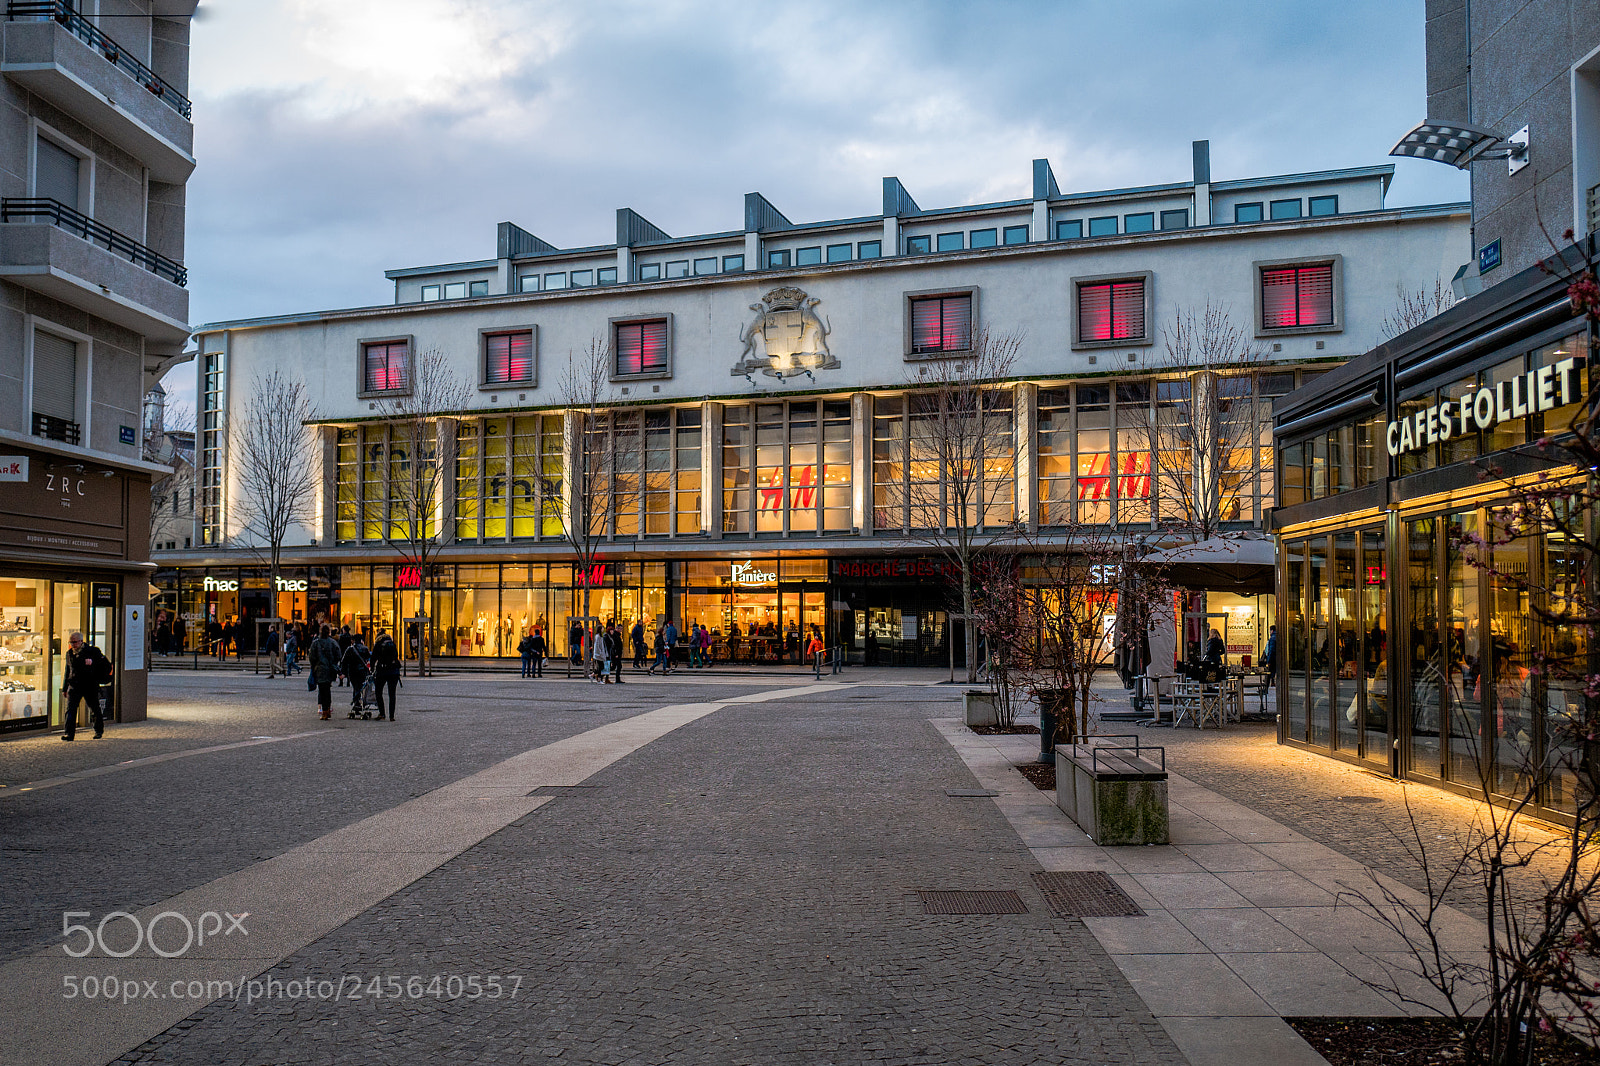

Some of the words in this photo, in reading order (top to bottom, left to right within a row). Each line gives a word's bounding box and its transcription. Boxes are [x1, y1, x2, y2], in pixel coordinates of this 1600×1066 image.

[1387, 402, 1452, 457] CAFES
[1460, 357, 1574, 436] FOLLIET
[462, 423, 498, 436] fnc
[47, 473, 86, 497] ZRC
[1078, 452, 1152, 504] HM
[760, 465, 828, 514] HM
[578, 564, 606, 586] HM
[731, 564, 777, 582] Panière
[838, 559, 901, 577] MARCHÉ
[906, 562, 936, 577] DES
[203, 576, 239, 592] fnac
